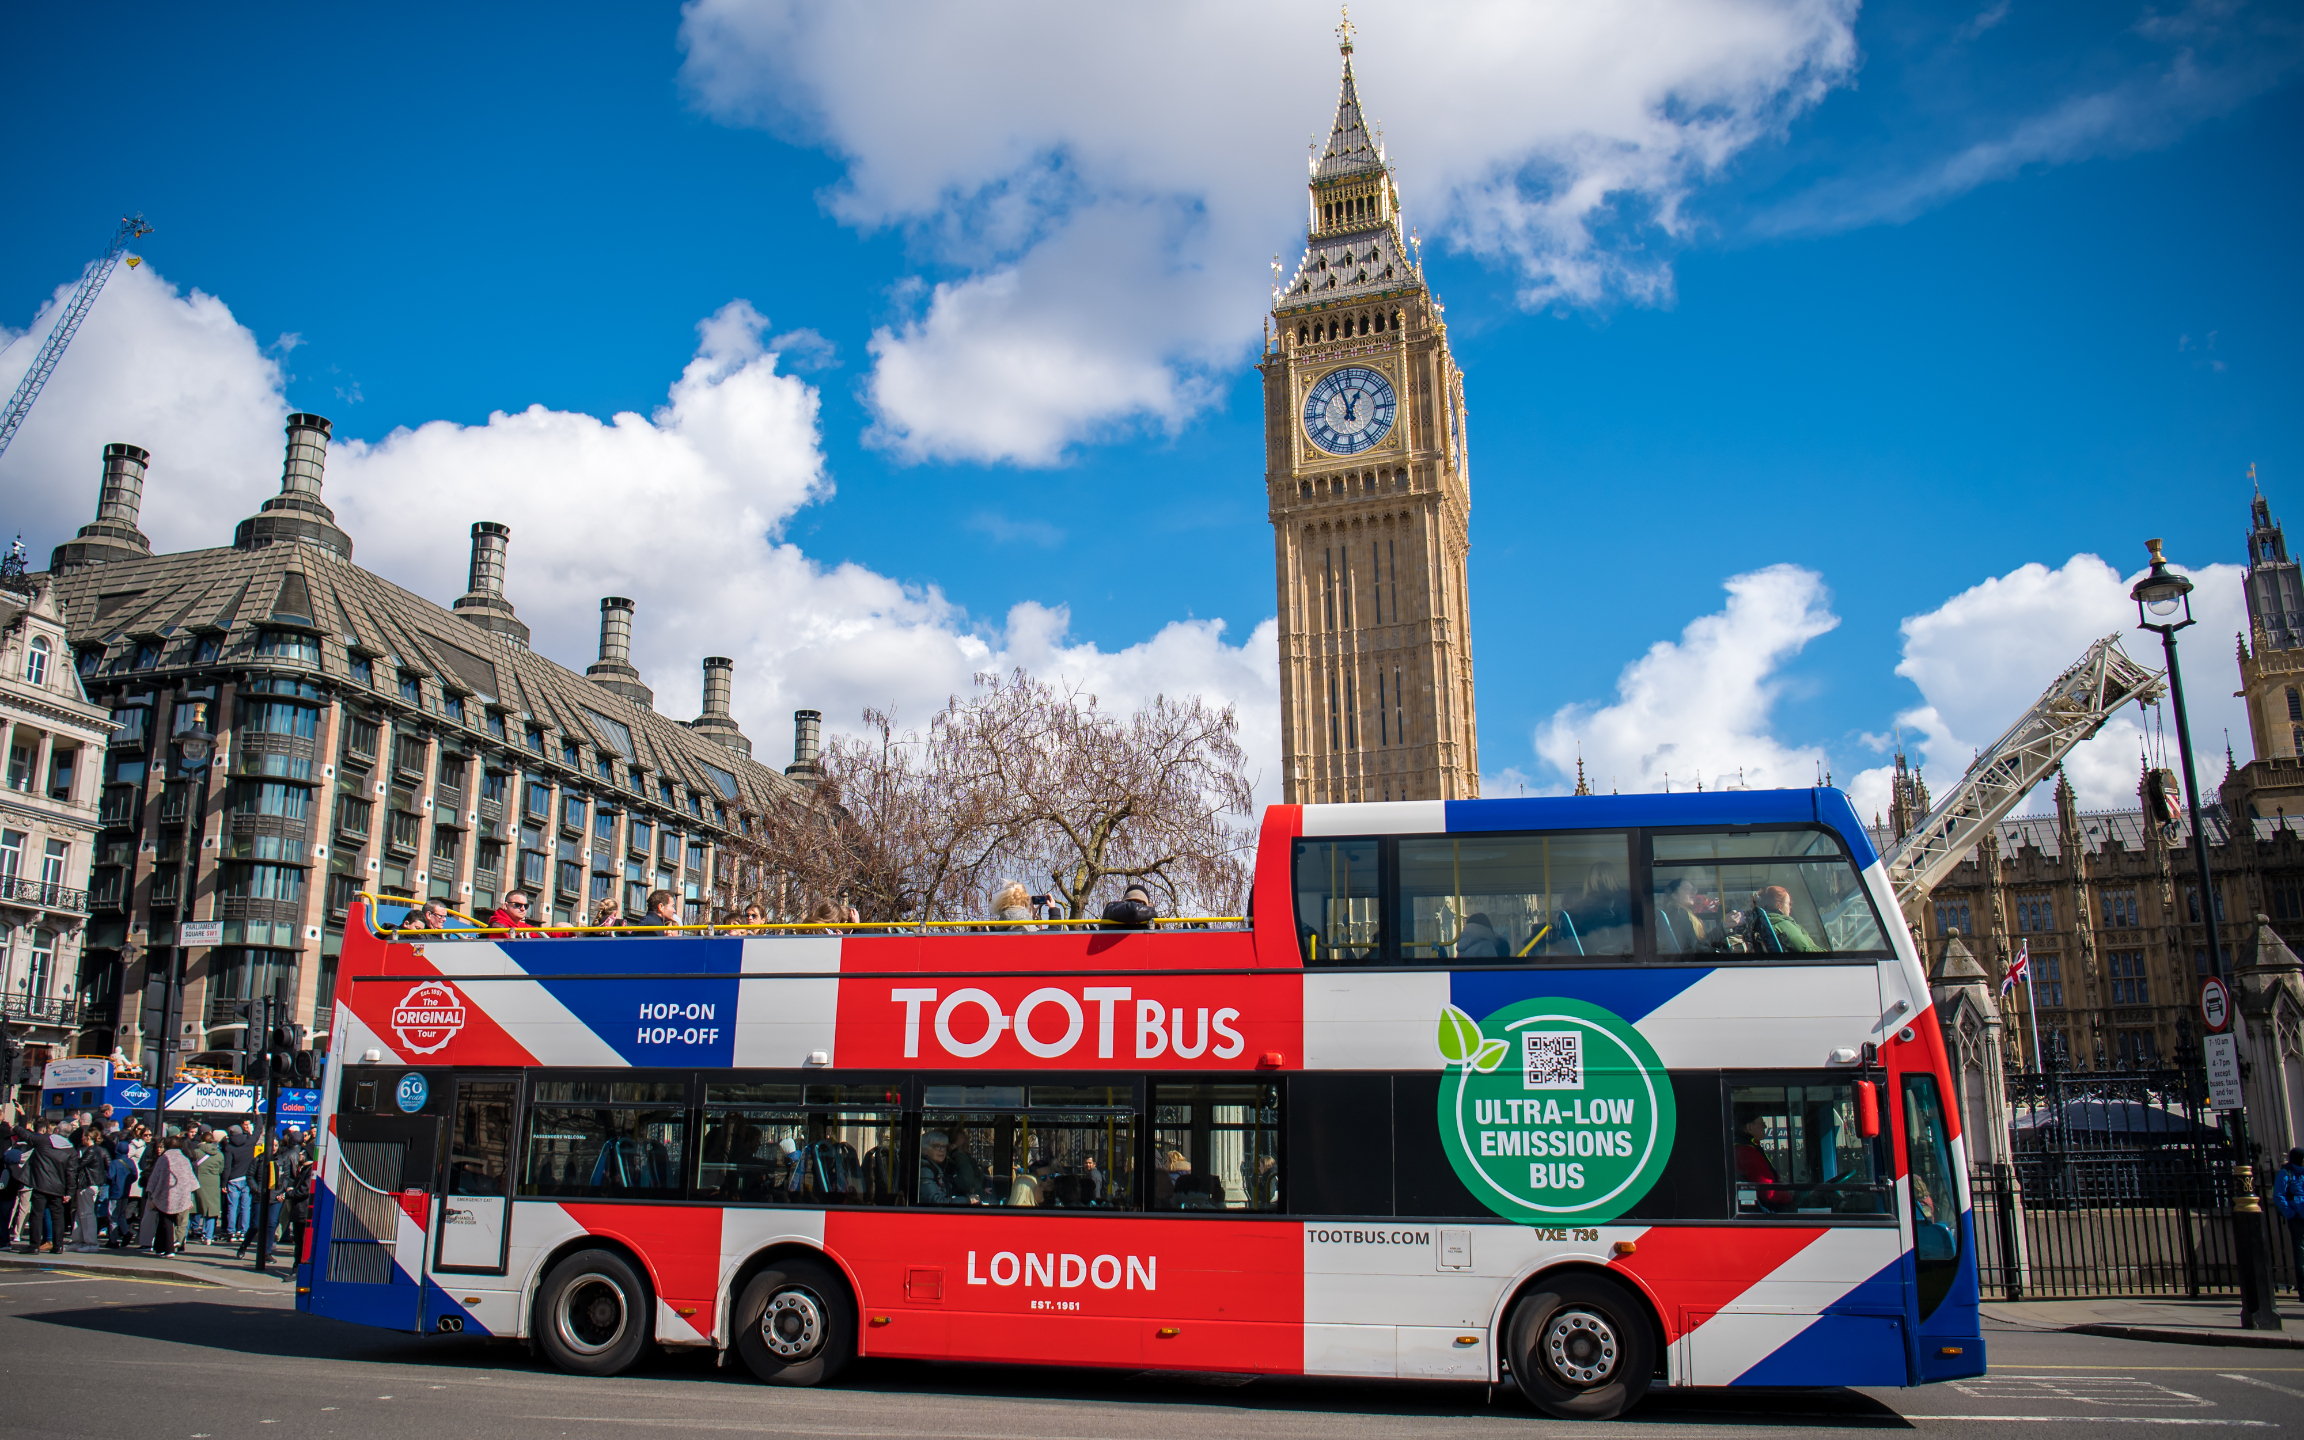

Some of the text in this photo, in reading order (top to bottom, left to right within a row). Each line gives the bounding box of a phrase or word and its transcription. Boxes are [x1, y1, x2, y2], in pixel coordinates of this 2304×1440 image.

[423, 998, 438, 1006] The
[396, 1011, 462, 1024] ORIGINAL
[639, 1003, 716, 1020] HOP-ON
[417, 1030, 437, 1038] Tour
[637, 1027, 719, 1045] HOP-OFF
[2215, 1048, 2224, 1056] and
[2214, 1069, 2231, 1077] except
[2225, 1078, 2239, 1086] taxis
[197, 1087, 228, 1097] HOP-ON
[400, 1081, 423, 1098] 60
[2216, 1088, 2225, 1096] and
[196, 1098, 234, 1108] LONDON
[1475, 1099, 1634, 1125] ULTRA-LOW
[1480, 1130, 1633, 1157] EMISSIONS
[1529, 1162, 1585, 1190] BUS
[1307, 1229, 1430, 1246] TOOTBUS.COM
[1534, 1228, 1599, 1242] VXE 736
[967, 1250, 1156, 1290] LONDON
[1031, 1300, 1080, 1311] EST. 1951
